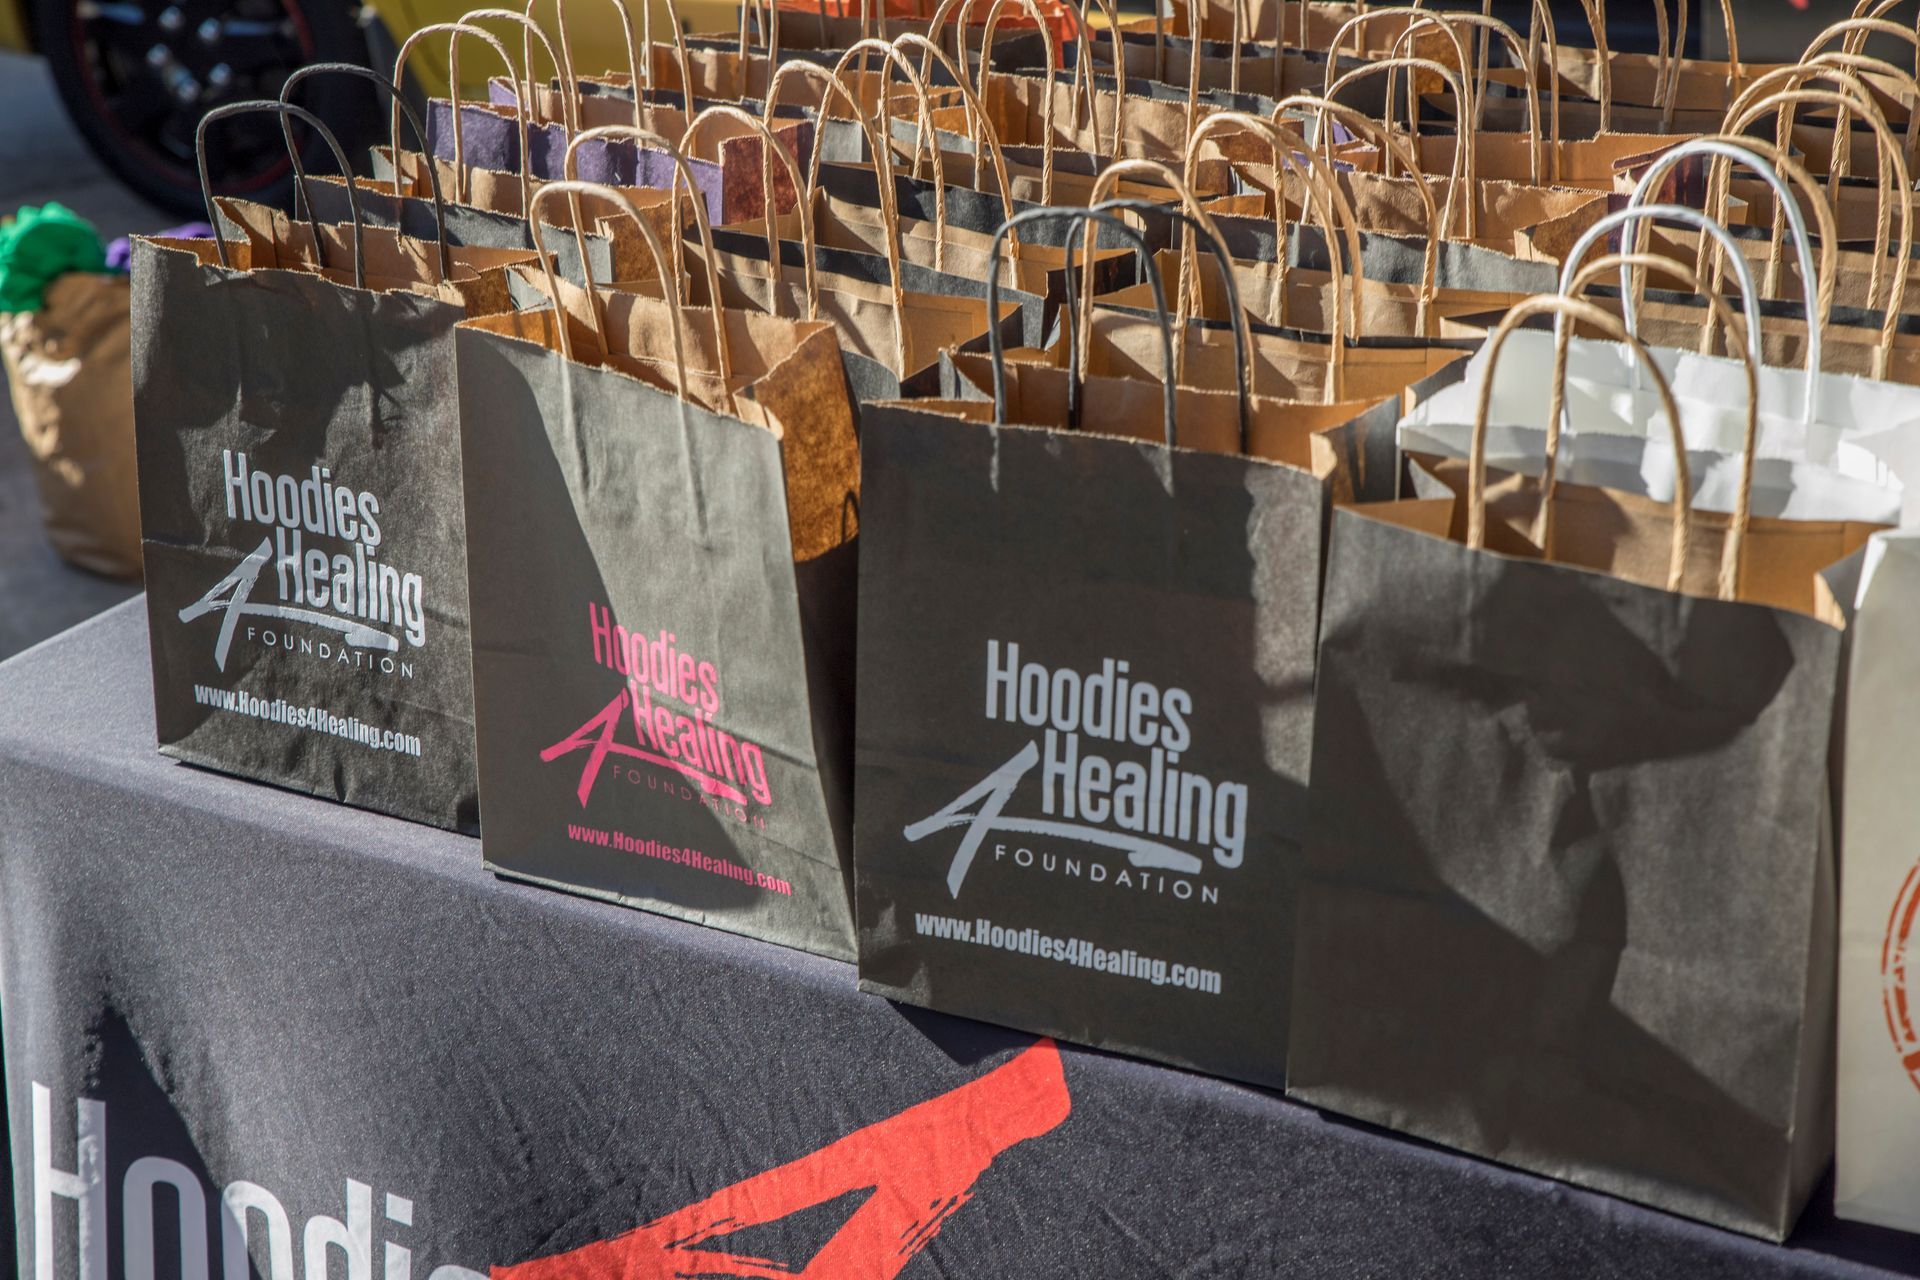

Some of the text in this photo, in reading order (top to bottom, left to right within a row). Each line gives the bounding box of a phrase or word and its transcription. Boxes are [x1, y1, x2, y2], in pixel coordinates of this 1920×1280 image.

[223, 449, 382, 546] Hoodies
[276, 526, 425, 648] Healing
[247, 627, 414, 679] FOUNDATION
[589, 601, 720, 714] Hoodies
[986, 639, 1192, 752] Hoodies
[194, 684, 421, 757] www.Hoodies4Healing.com
[630, 679, 772, 806] Healing
[613, 765, 766, 831] FOUNDATION
[1042, 728, 1248, 869] Healing
[567, 823, 792, 896] www.Hoodies4Healing.com
[995, 844, 1219, 904] FOUNDATION
[915, 913, 1222, 994] www.Hoodies4Healing.com
